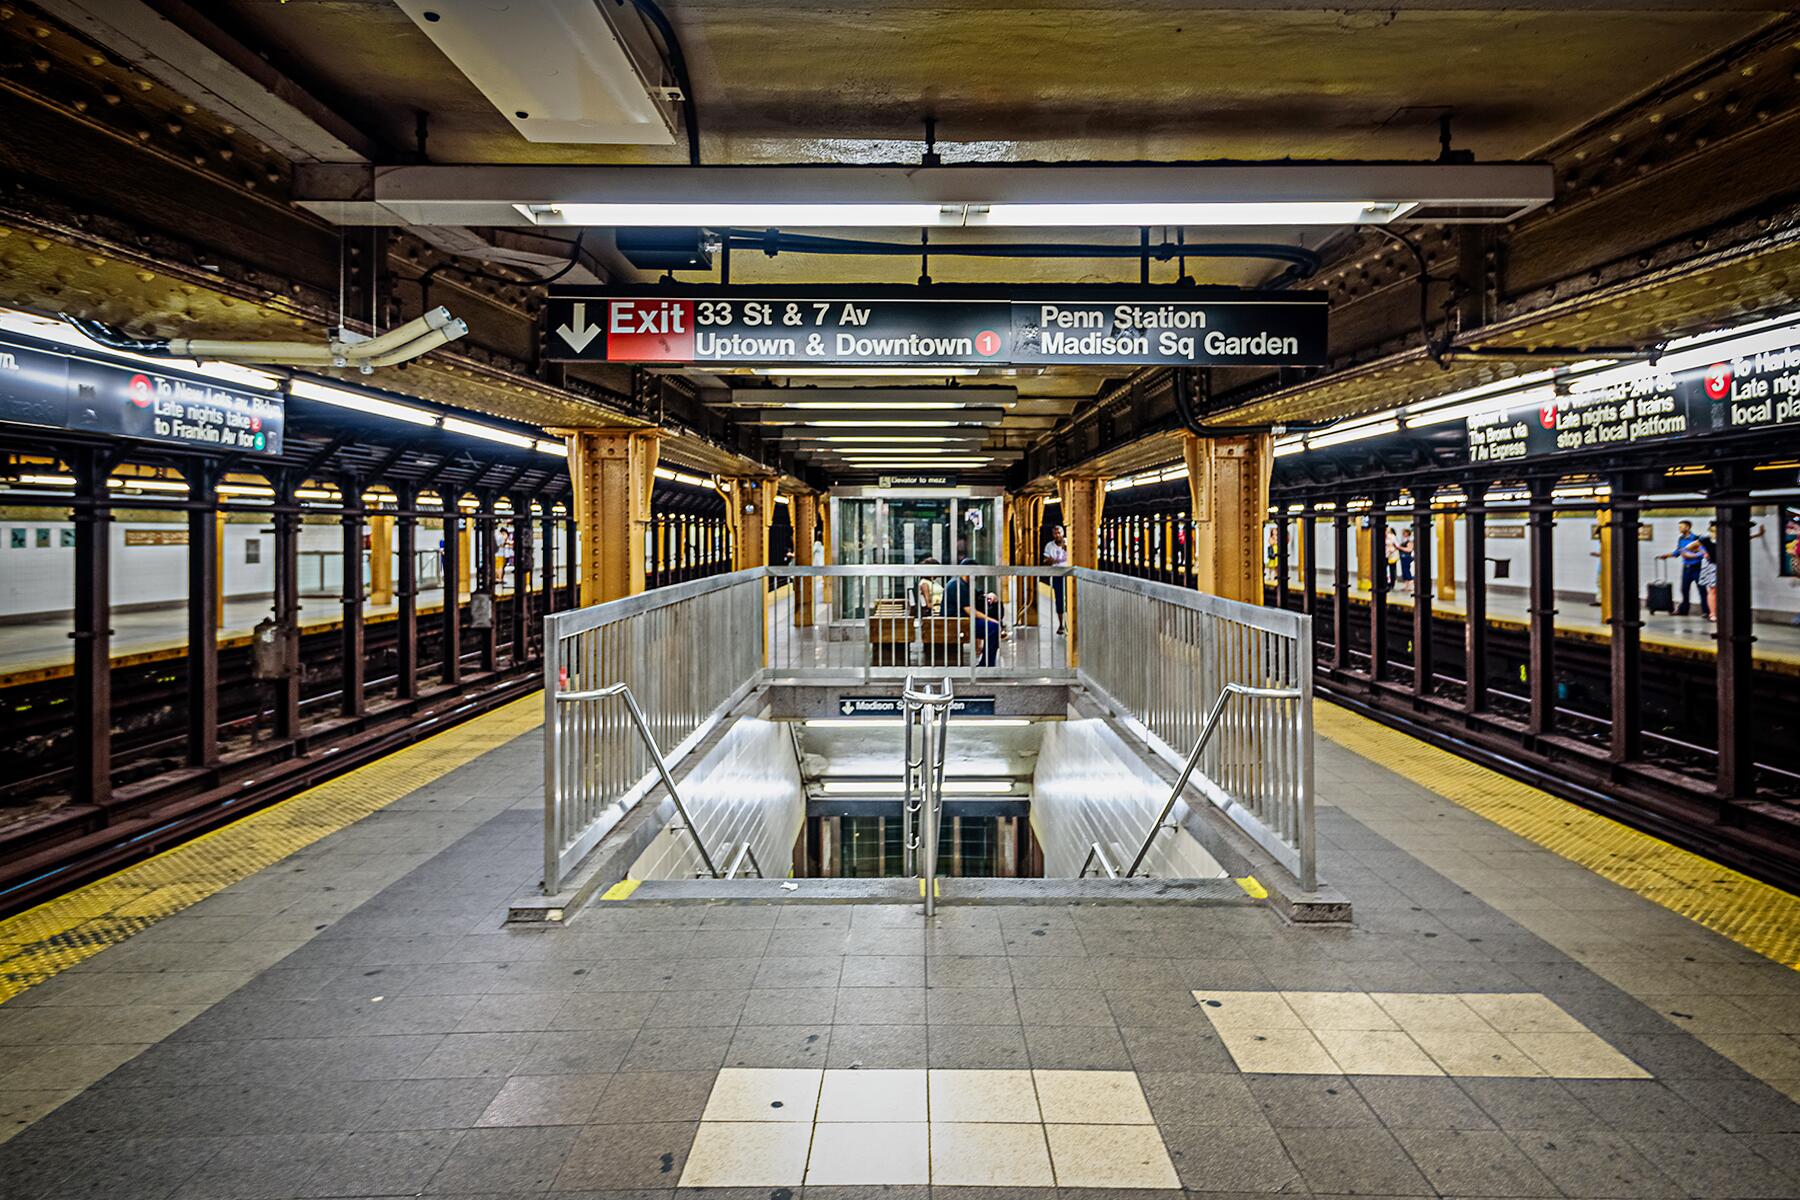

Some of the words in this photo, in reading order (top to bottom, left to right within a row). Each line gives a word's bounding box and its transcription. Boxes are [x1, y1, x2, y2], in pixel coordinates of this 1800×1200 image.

[610, 302, 685, 333] Exit
[697, 302, 732, 326] 33
[743, 302, 773, 326] St
[782, 303, 803, 326] &
[813, 303, 830, 326] 7
[839, 303, 871, 326] Av
[1041, 305, 1103, 329] Penn
[1114, 305, 1206, 329] Station
[696, 332, 795, 359] Uptown
[805, 333, 825, 356] &
[836, 333, 972, 356] Downtown
[1041, 332, 1148, 355] Madison
[1158, 332, 1195, 359] Sq
[1204, 332, 1298, 355] Garden
[154, 377, 171, 396] To
[1731, 378, 1769, 401] Late
[154, 399, 183, 418] Late
[187, 405, 223, 425] nights
[226, 411, 251, 429] take
[1556, 412, 1581, 430] Late
[1582, 407, 1618, 427] nights
[1619, 399, 1636, 419] all
[1636, 395, 1675, 416] trains
[1731, 399, 1772, 425] local
[155, 418, 170, 434] to
[173, 420, 219, 443] Franklin
[222, 427, 237, 444] Av
[238, 430, 256, 447] for
[1469, 430, 1485, 445] The
[1486, 427, 1512, 443] Bronx
[1556, 430, 1583, 449] stop
[1584, 427, 1598, 443] at
[1598, 421, 1628, 442] local
[1629, 414, 1687, 441] platform
[1469, 446, 1478, 461] 7
[1489, 441, 1526, 460] Express
[856, 701, 894, 711] Madison
